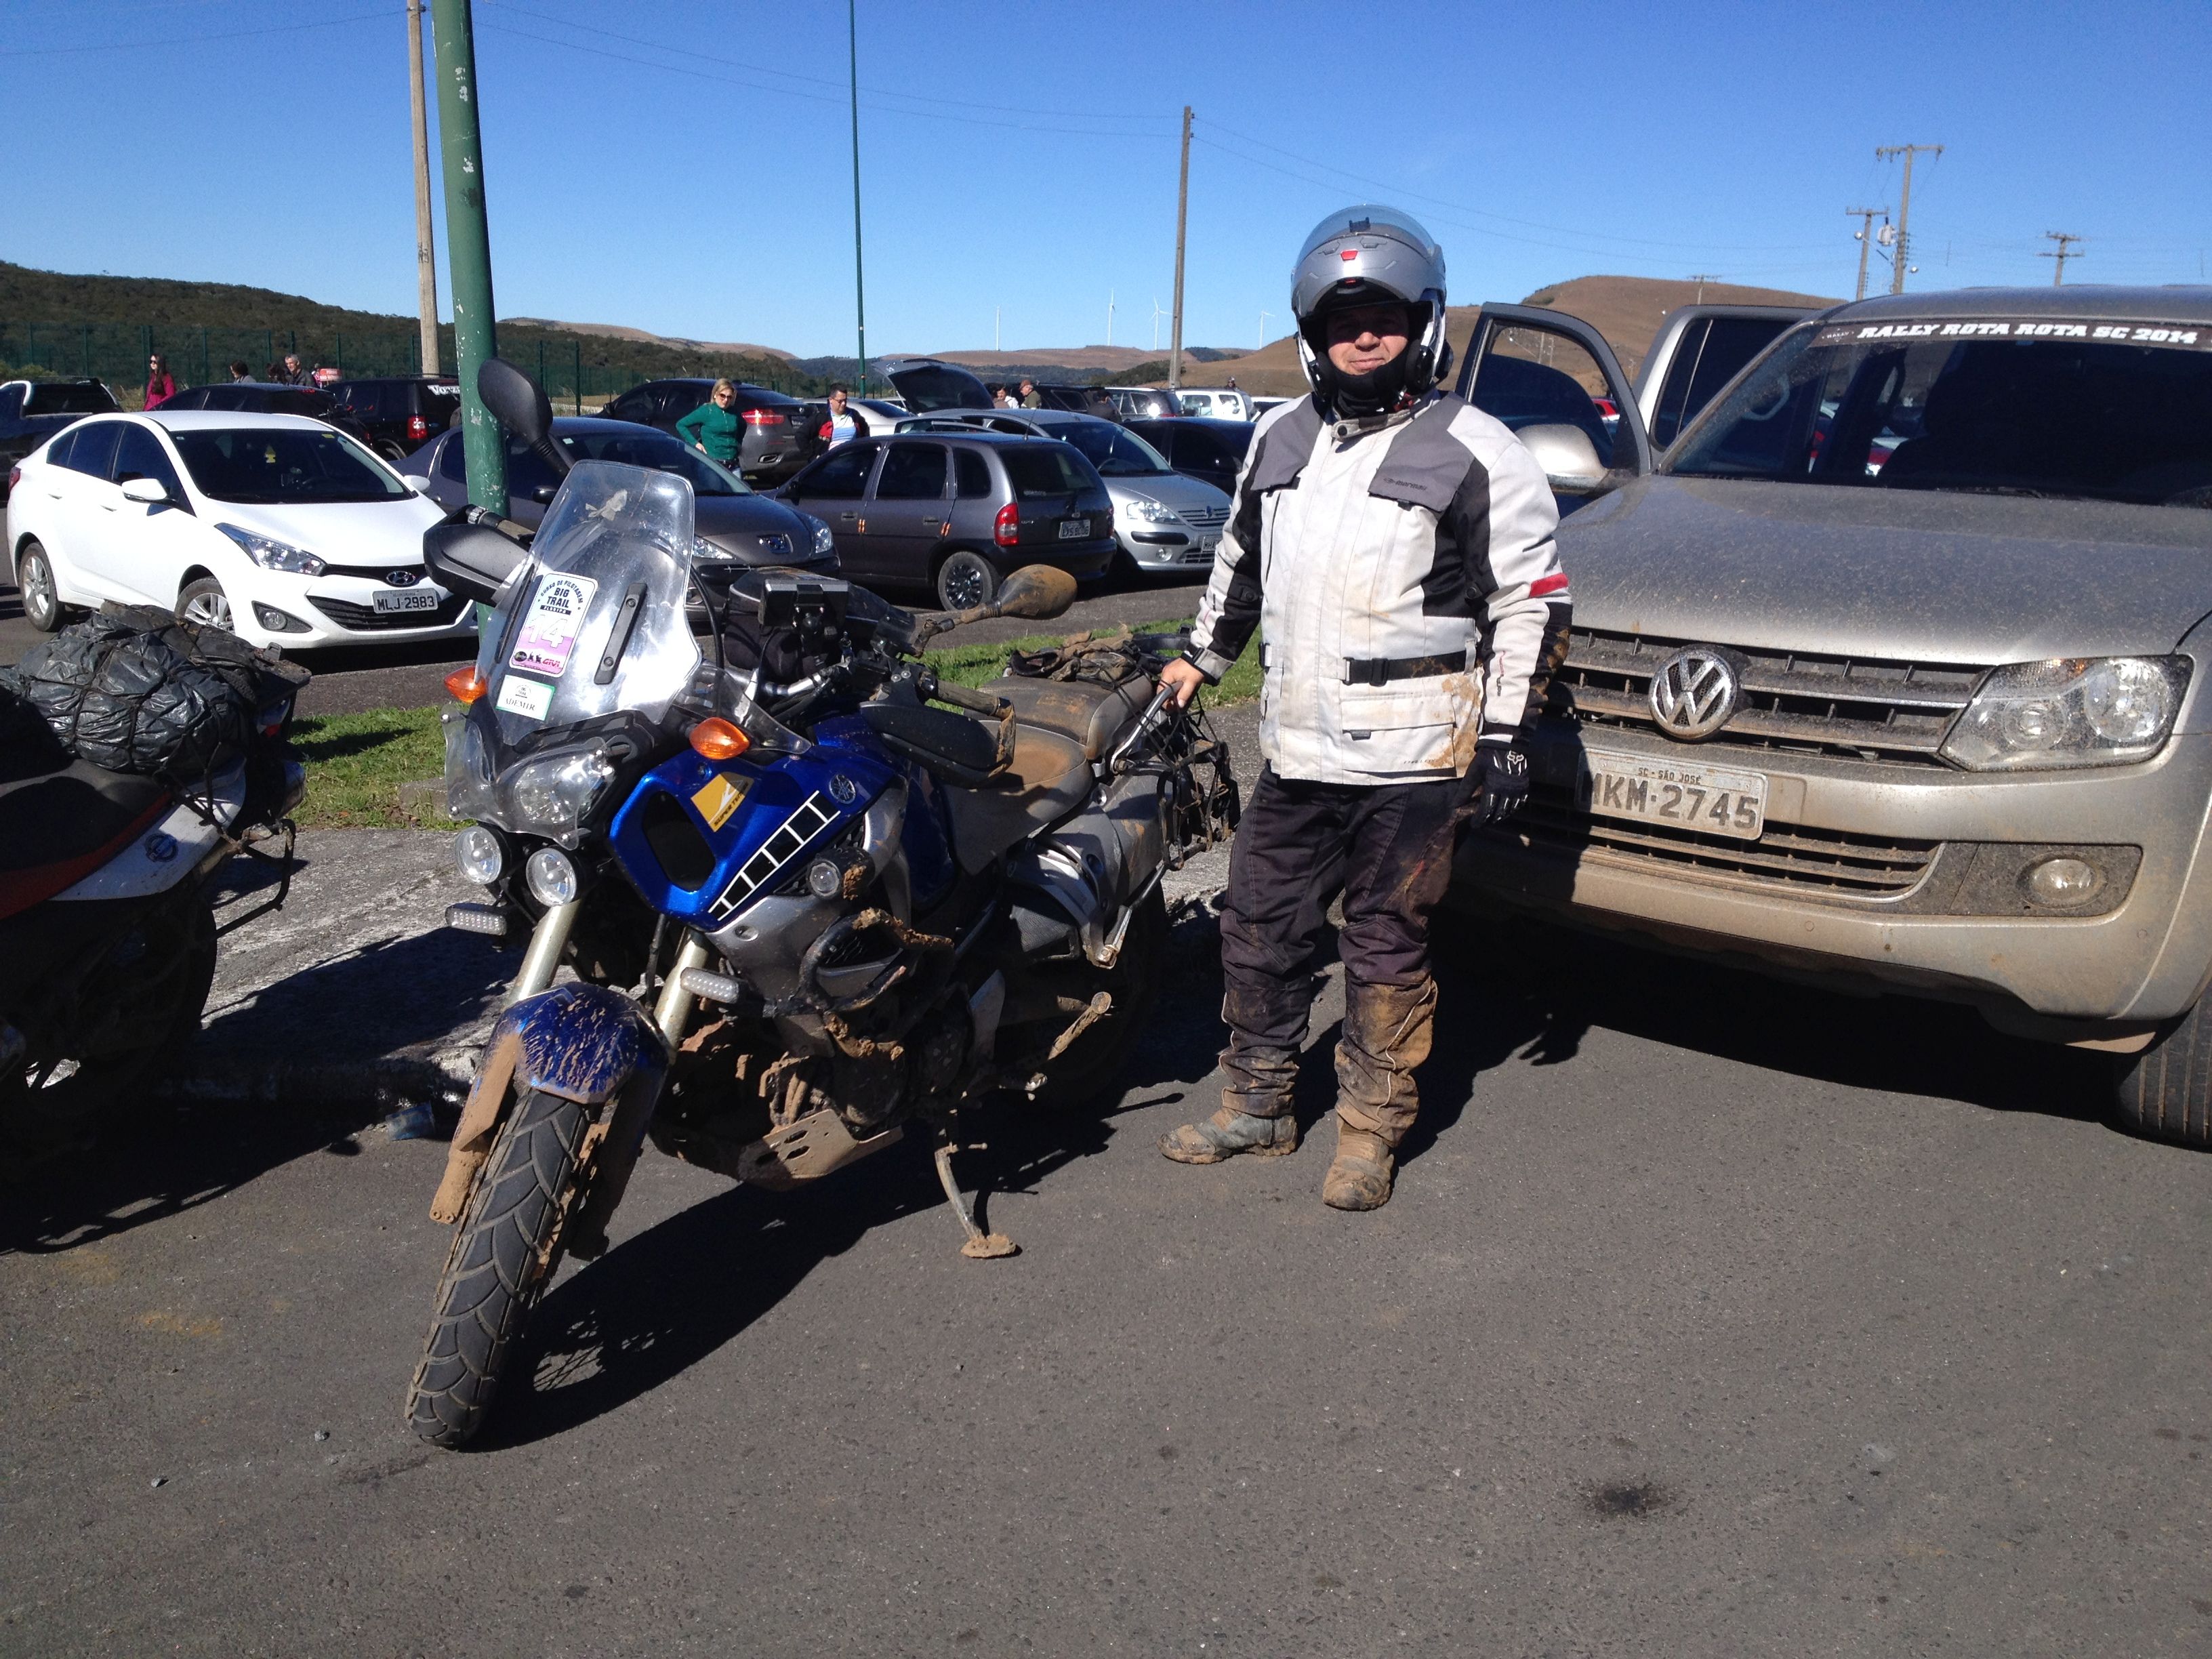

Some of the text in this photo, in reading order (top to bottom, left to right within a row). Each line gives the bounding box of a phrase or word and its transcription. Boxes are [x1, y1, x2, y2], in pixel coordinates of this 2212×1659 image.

[1857, 323, 2198, 344] RALLY ROTA ROTA SC 2014
[554, 588, 570, 598] BIG
[546, 596, 570, 608] TRAIL
[528, 614, 568, 649] 14
[506, 697, 535, 711] ADEMIR
[714, 804, 733, 827] SUPER
